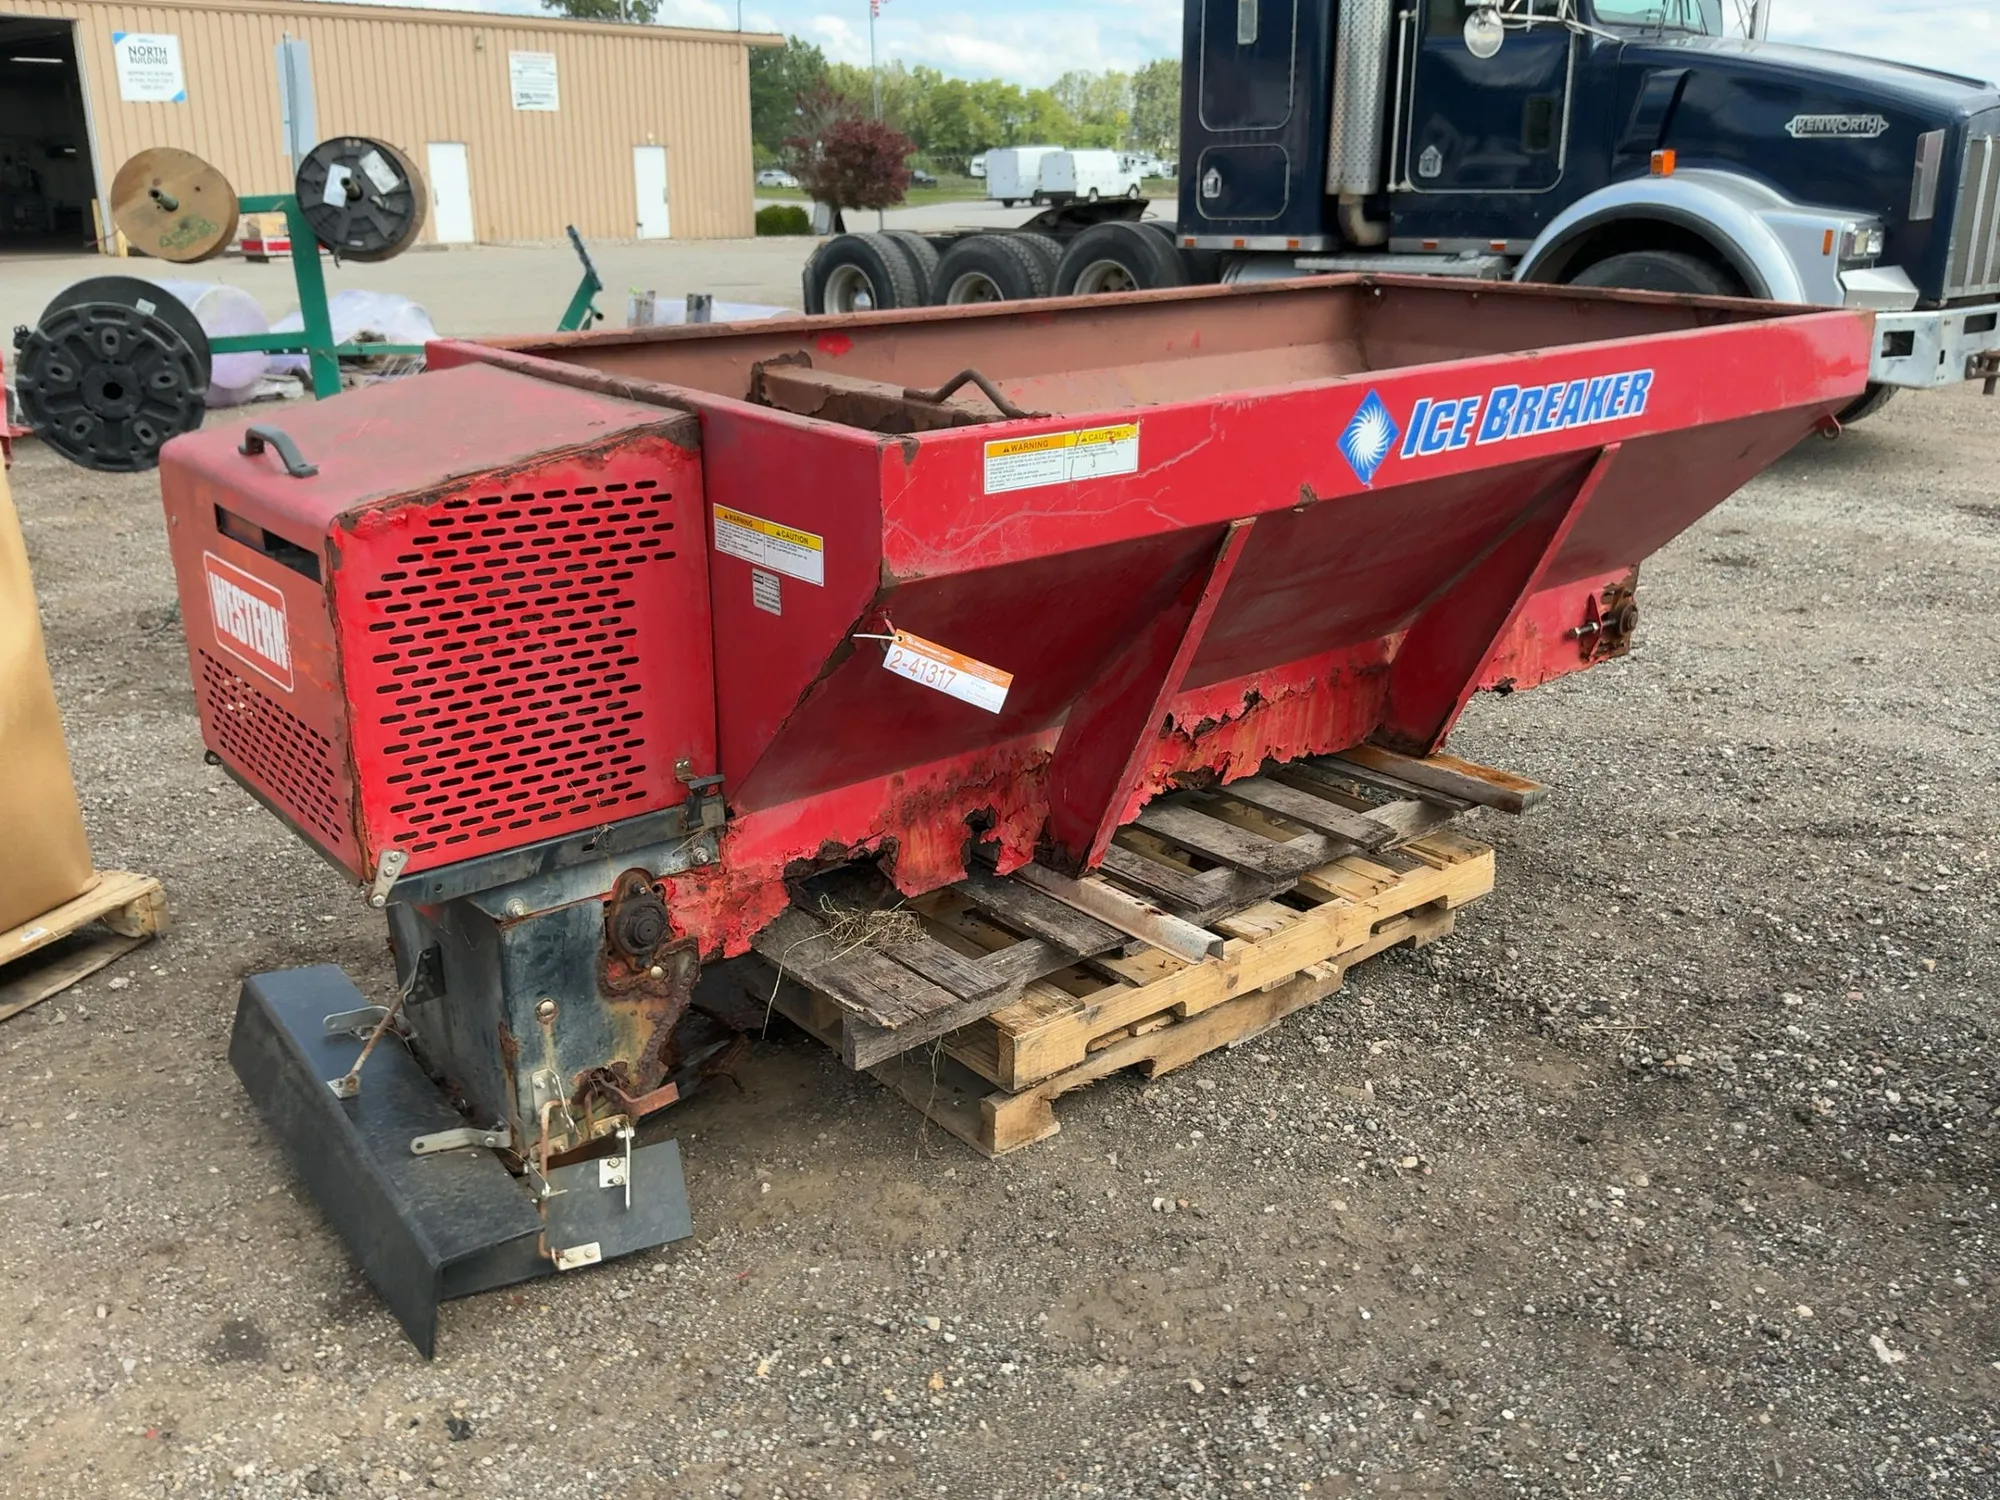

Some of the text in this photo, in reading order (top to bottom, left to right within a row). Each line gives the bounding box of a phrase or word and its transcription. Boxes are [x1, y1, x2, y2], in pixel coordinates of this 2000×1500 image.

[127, 45, 167, 57] NORTH
[129, 56, 168, 65] BUILDING
[1796, 117, 1878, 133] KENWORTH
[1400, 369, 1654, 460] ICE BREAKER
[1089, 430, 1122, 442] CAUTON
[1011, 440, 1049, 452] WARNING
[728, 513, 754, 528] WARNING
[781, 530, 809, 545] CAUTION
[208, 571, 289, 672] WESTERN
[888, 650, 957, 690] 2-41317
